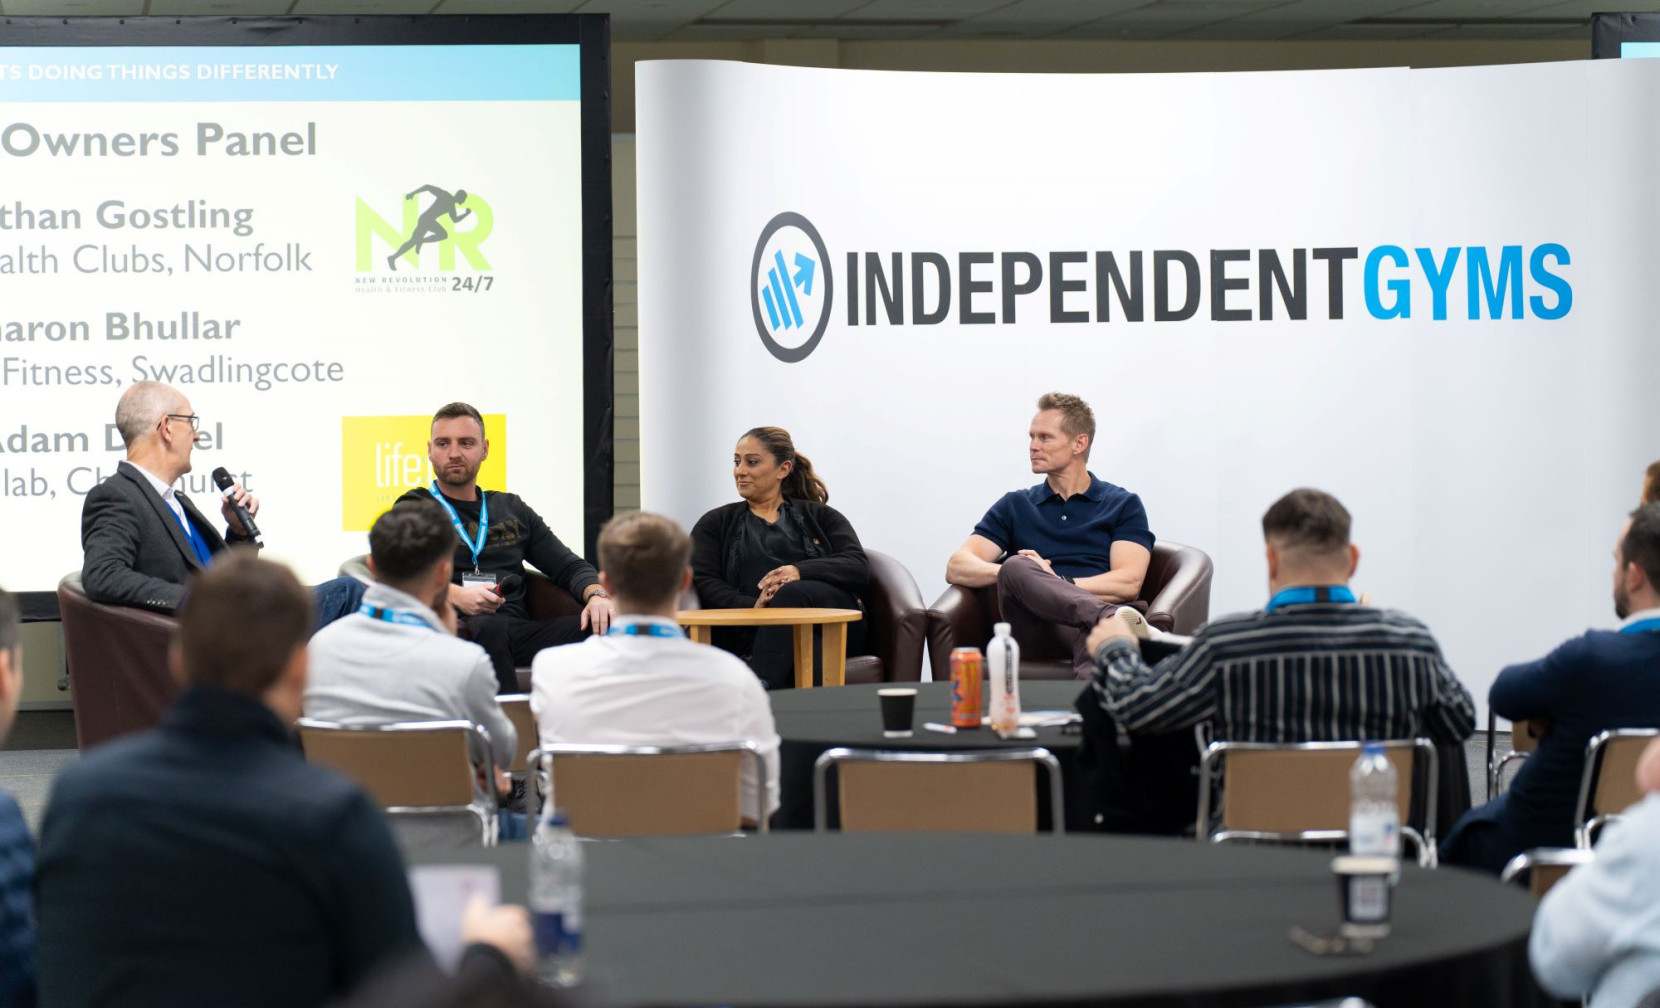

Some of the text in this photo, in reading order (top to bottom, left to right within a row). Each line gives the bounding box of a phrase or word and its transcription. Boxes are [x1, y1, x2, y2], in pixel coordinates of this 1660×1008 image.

[29, 64, 102, 80] DOING
[106, 64, 190, 80] THINGS
[197, 64, 339, 80] DIFFERENTLY
[1, 121, 317, 157] Owners Panel
[0, 199, 254, 237] than Gostling
[0, 242, 312, 276] alth Clubs, Norfolk
[382, 276, 448, 284] REVOLUTION
[451, 275, 494, 294] 24/7
[846, 242, 1573, 326] INDEPENDENTGYMS
[0, 311, 241, 342] aron Bhullar
[4, 353, 344, 391] Fitness, Swadlingcote
[0, 422, 223, 453] dam Del
[4, 467, 56, 500] lab,
